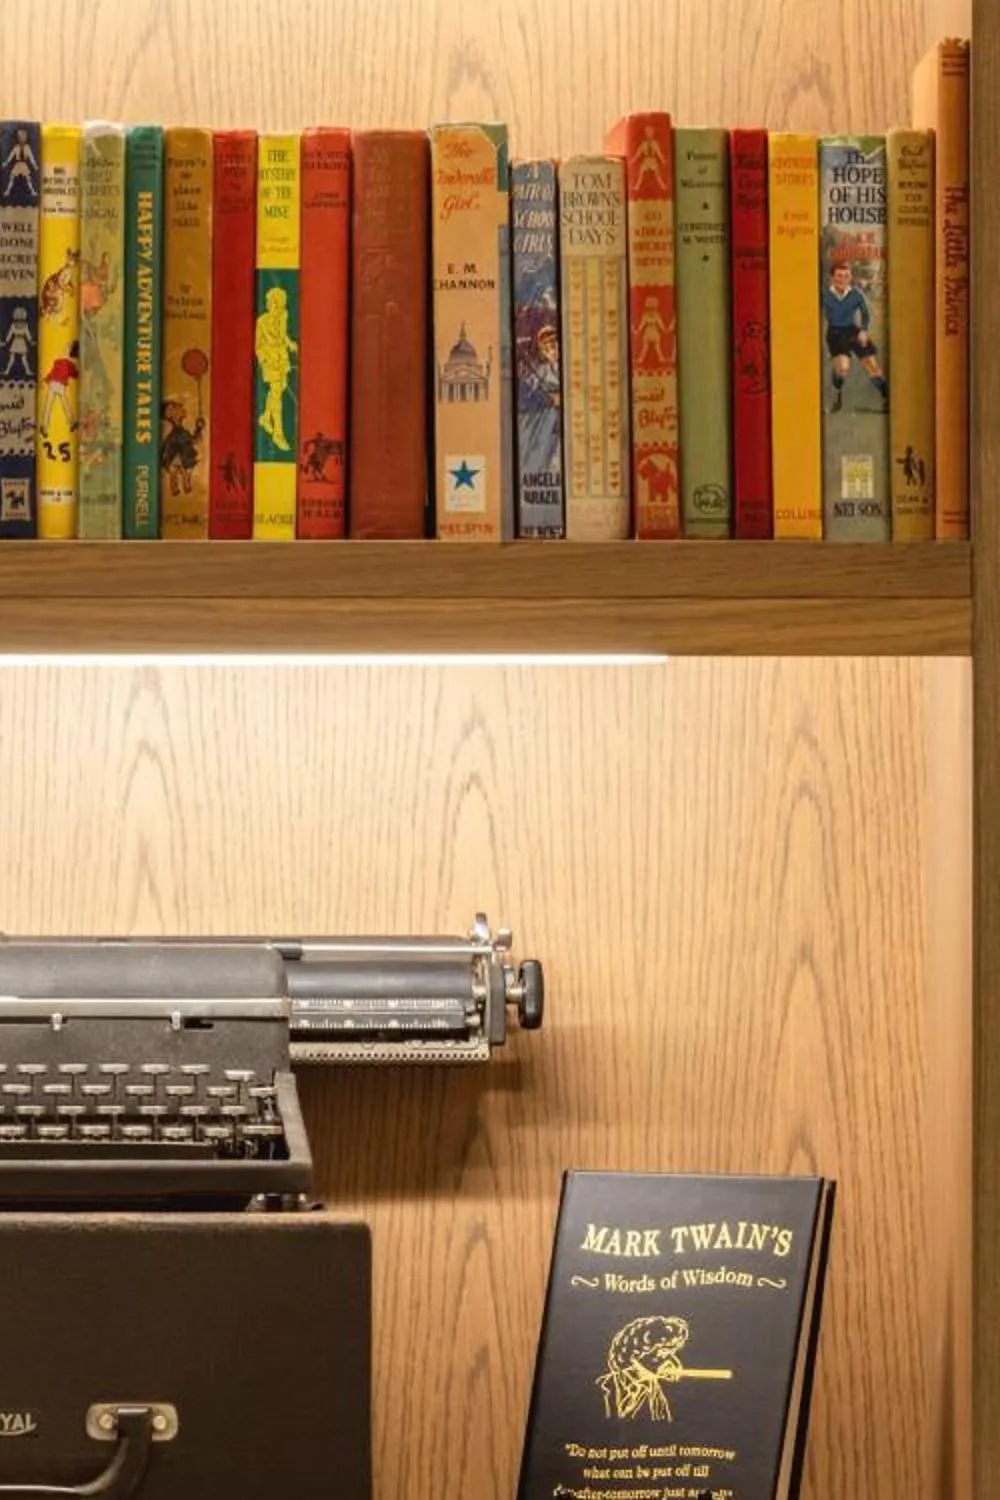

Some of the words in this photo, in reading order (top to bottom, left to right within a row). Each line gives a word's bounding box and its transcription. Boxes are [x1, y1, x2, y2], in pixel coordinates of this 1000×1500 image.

[572, 173, 611, 189] TOM
[833, 167, 884, 184] HOPE
[563, 191, 619, 207] BROWN'S
[829, 186, 851, 204] OF
[857, 186, 887, 204] HIS
[828, 206, 888, 225] HOUSE
[2, 223, 34, 233] WELL
[135, 191, 153, 259] HAPPY
[0, 238, 34, 248] DONE
[568, 228, 616, 245] DAYS
[0, 270, 34, 280] SEVEN
[436, 279, 496, 291] HANNON
[135, 264, 153, 375] ADVENTURE
[135, 380, 153, 444] TALES
[135, 465, 150, 528] PURNELL
[833, 502, 883, 517] NELSON
[580, 1223, 662, 1258] MARK
[671, 1221, 794, 1257] TWAIN'S
[603, 1272, 656, 1294] Words
[660, 1269, 679, 1290] of
[682, 1267, 754, 1289] Wisdom
[587, 1446, 608, 1459] not
[608, 1446, 630, 1460] put
[631, 1444, 650, 1459] off
[649, 1443, 678, 1458] until
[678, 1444, 736, 1461] tomorrow
[583, 1465, 611, 1479] what
[612, 1467, 633, 1479] can
[636, 1464, 650, 1479] be
[651, 1466, 673, 1481] put
[674, 1463, 692, 1478] off
[692, 1464, 710, 1478] till
[662, 1486, 685, 1500] just
